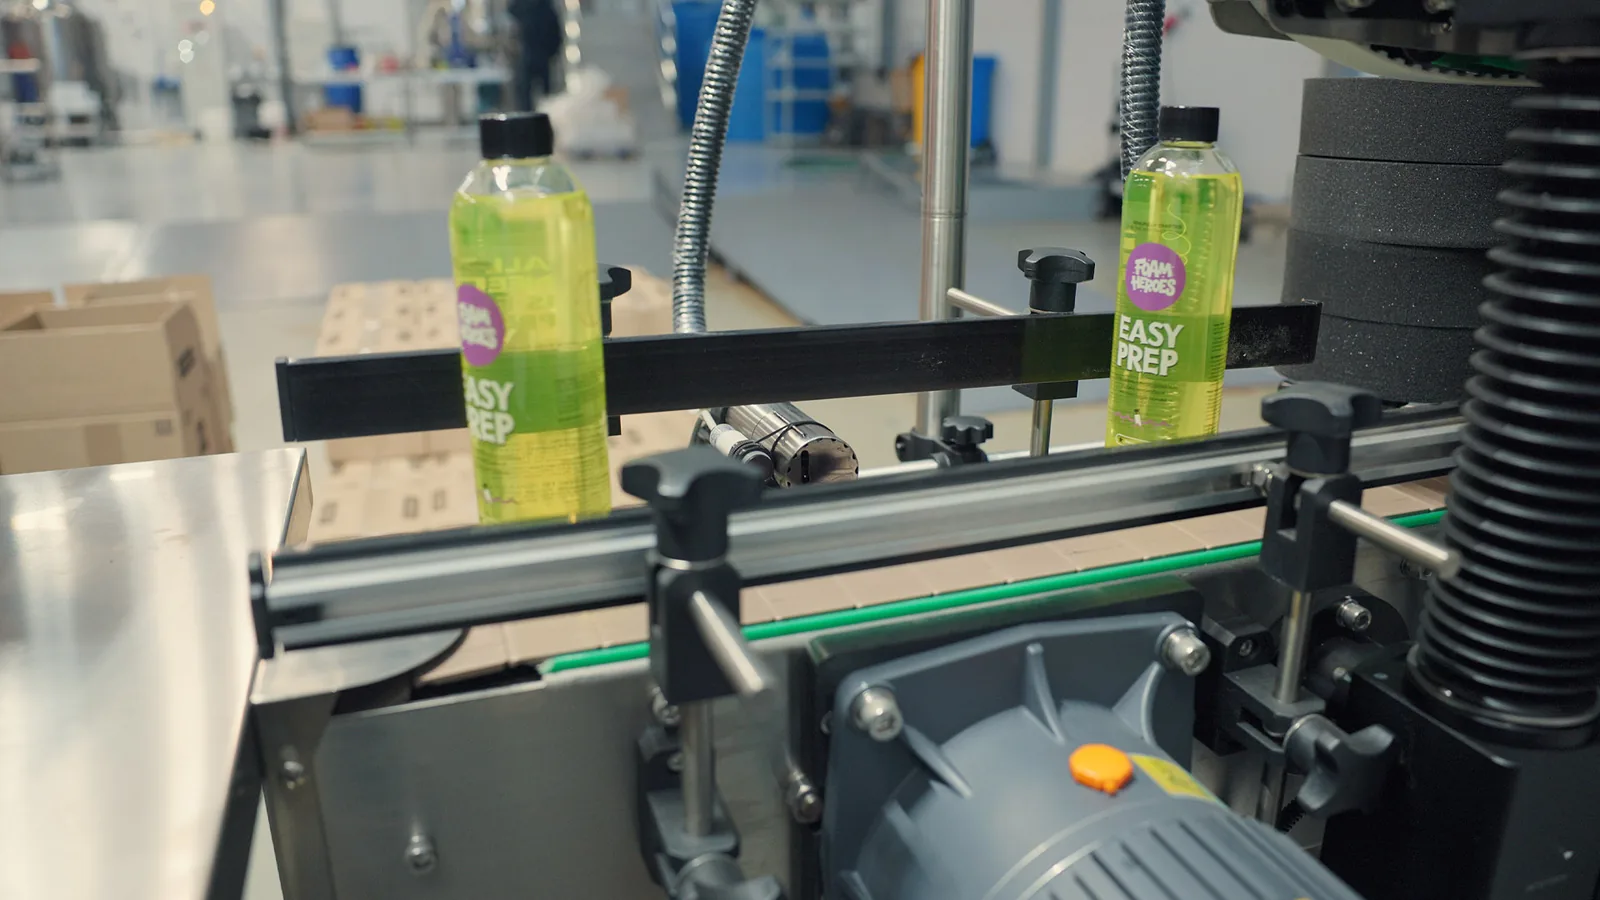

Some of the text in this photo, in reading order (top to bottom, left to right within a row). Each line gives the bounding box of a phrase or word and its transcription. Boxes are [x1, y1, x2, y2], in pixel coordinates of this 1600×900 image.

[1133, 258, 1174, 278] FOAM
[1130, 275, 1177, 297] HEROES
[1119, 314, 1184, 349] EASY
[1117, 340, 1179, 376] PREP
[464, 375, 514, 412] ASY
[466, 405, 515, 445] REP
